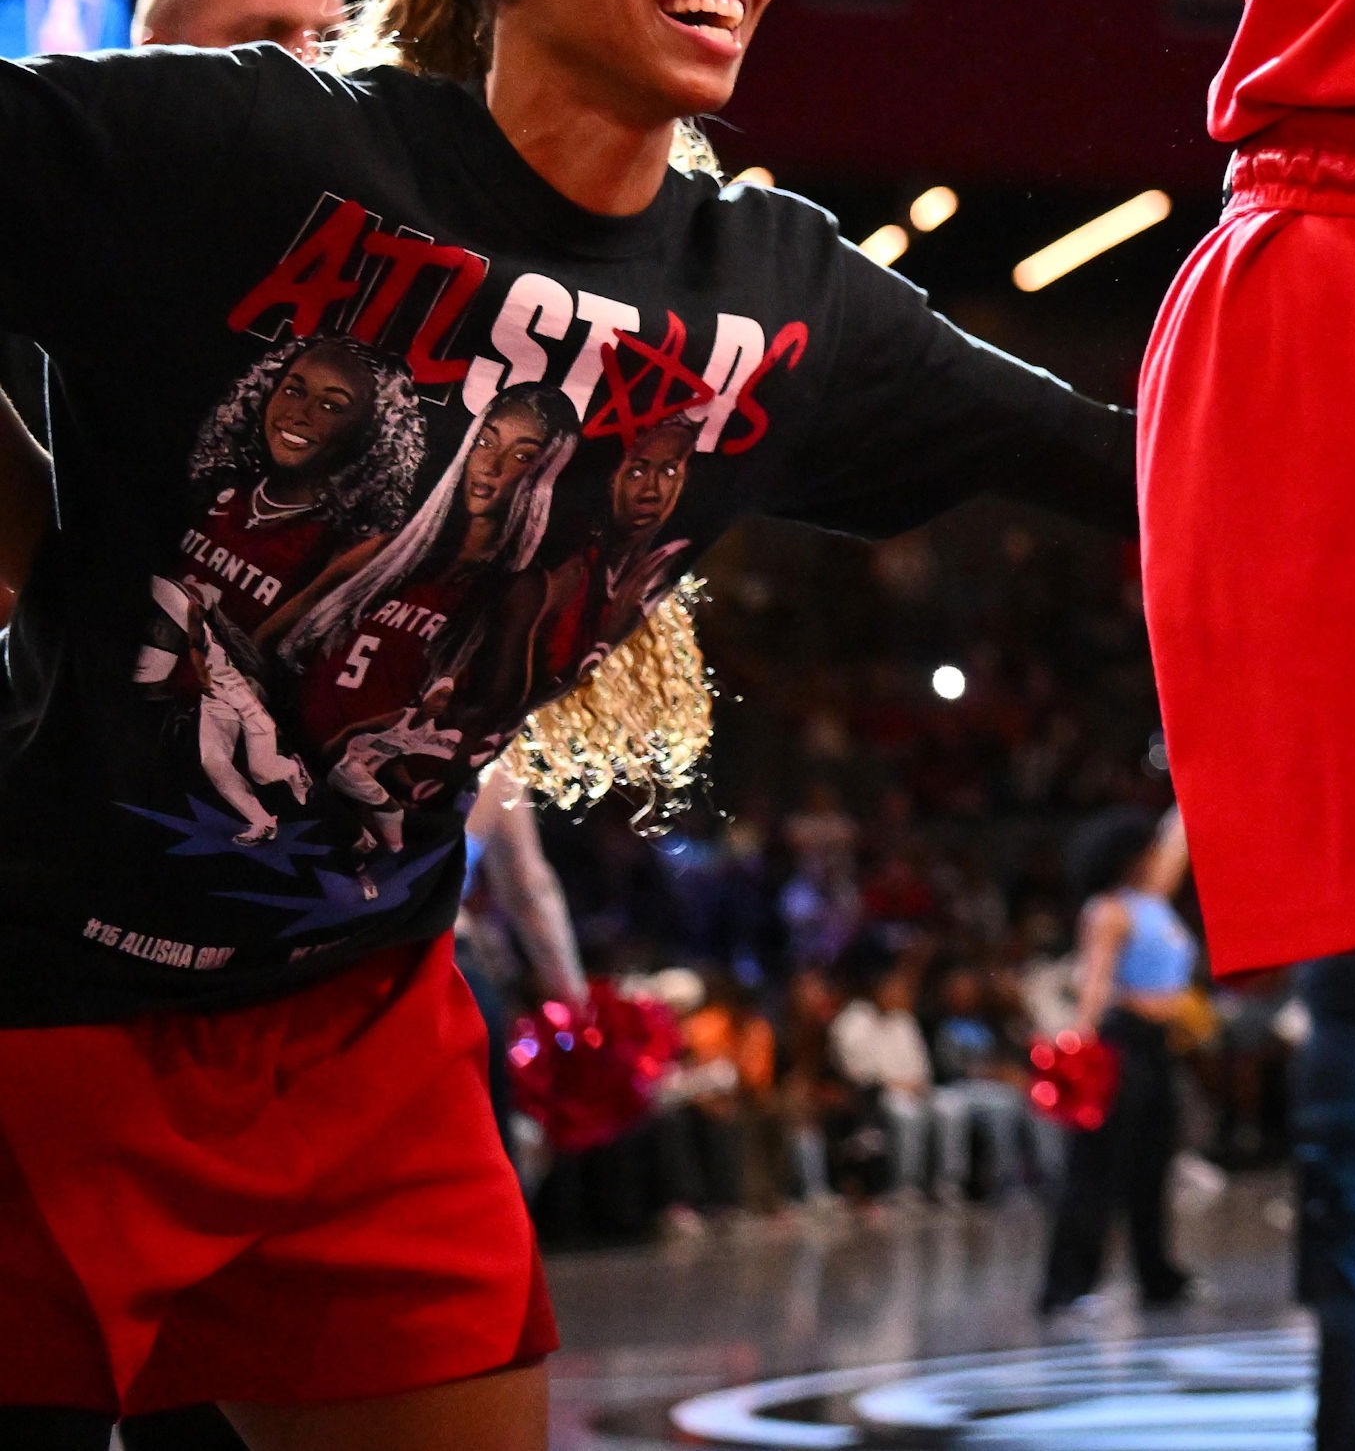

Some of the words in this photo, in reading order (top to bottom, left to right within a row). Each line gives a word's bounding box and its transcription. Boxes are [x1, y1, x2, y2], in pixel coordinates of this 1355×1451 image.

[364, 599, 449, 642] ANTA
[336, 633, 383, 690] 5
[83, 917, 123, 948] #15
[119, 931, 193, 969] ALLISHA
